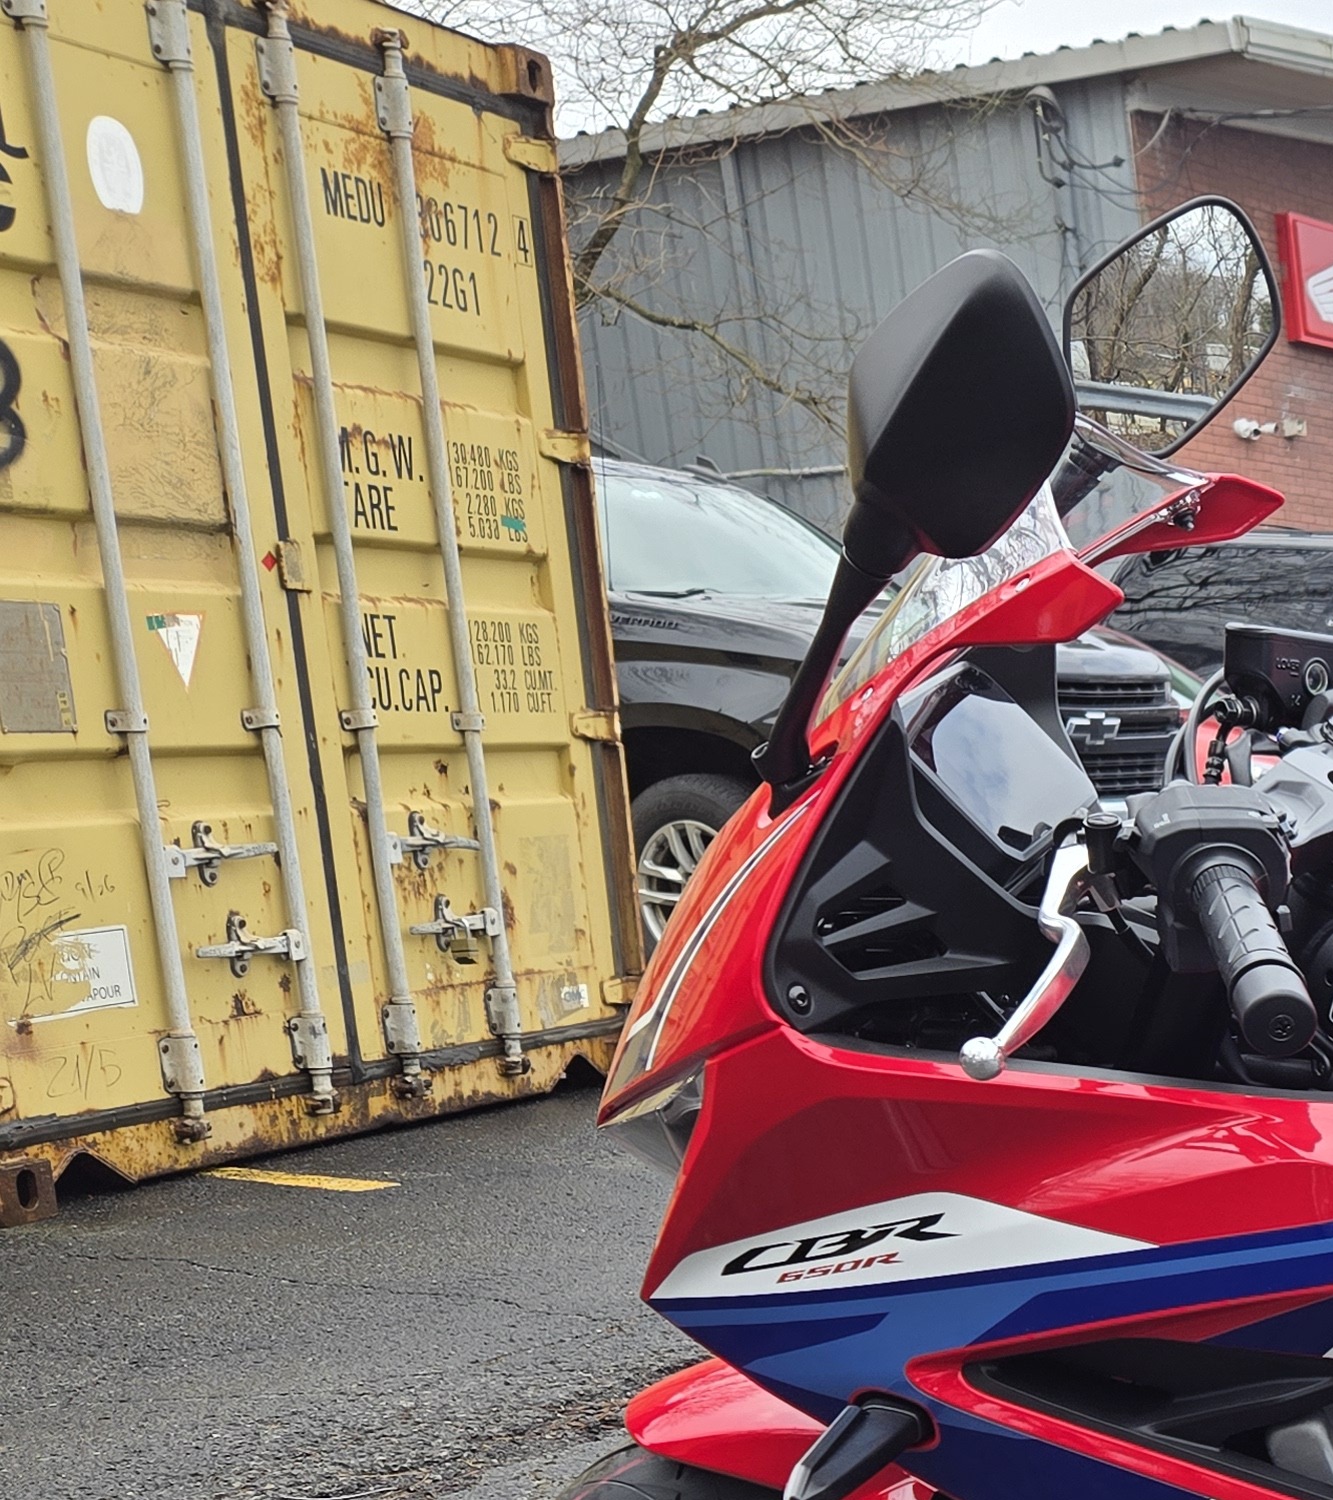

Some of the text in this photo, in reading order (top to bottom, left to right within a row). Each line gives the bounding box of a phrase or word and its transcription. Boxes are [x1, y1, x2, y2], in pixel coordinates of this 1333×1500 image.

[320, 167, 385, 227] MEDU
[517, 220, 529, 263] 4
[423, 259, 480, 316] 22G1
[498, 447, 519, 472] KGS
[501, 473, 522, 495] LBS
[344, 481, 398, 531] ARE
[474, 621, 512, 643] 28.200
[518, 623, 539, 643] KGS
[522, 646, 542, 666] LBS
[494, 669, 517, 690] 33.2
[491, 692, 520, 713] 1.170
[81, 984, 121, 1002] APOUR
[721, 1212, 963, 1276] CBR
[776, 1252, 904, 1284] 650R
